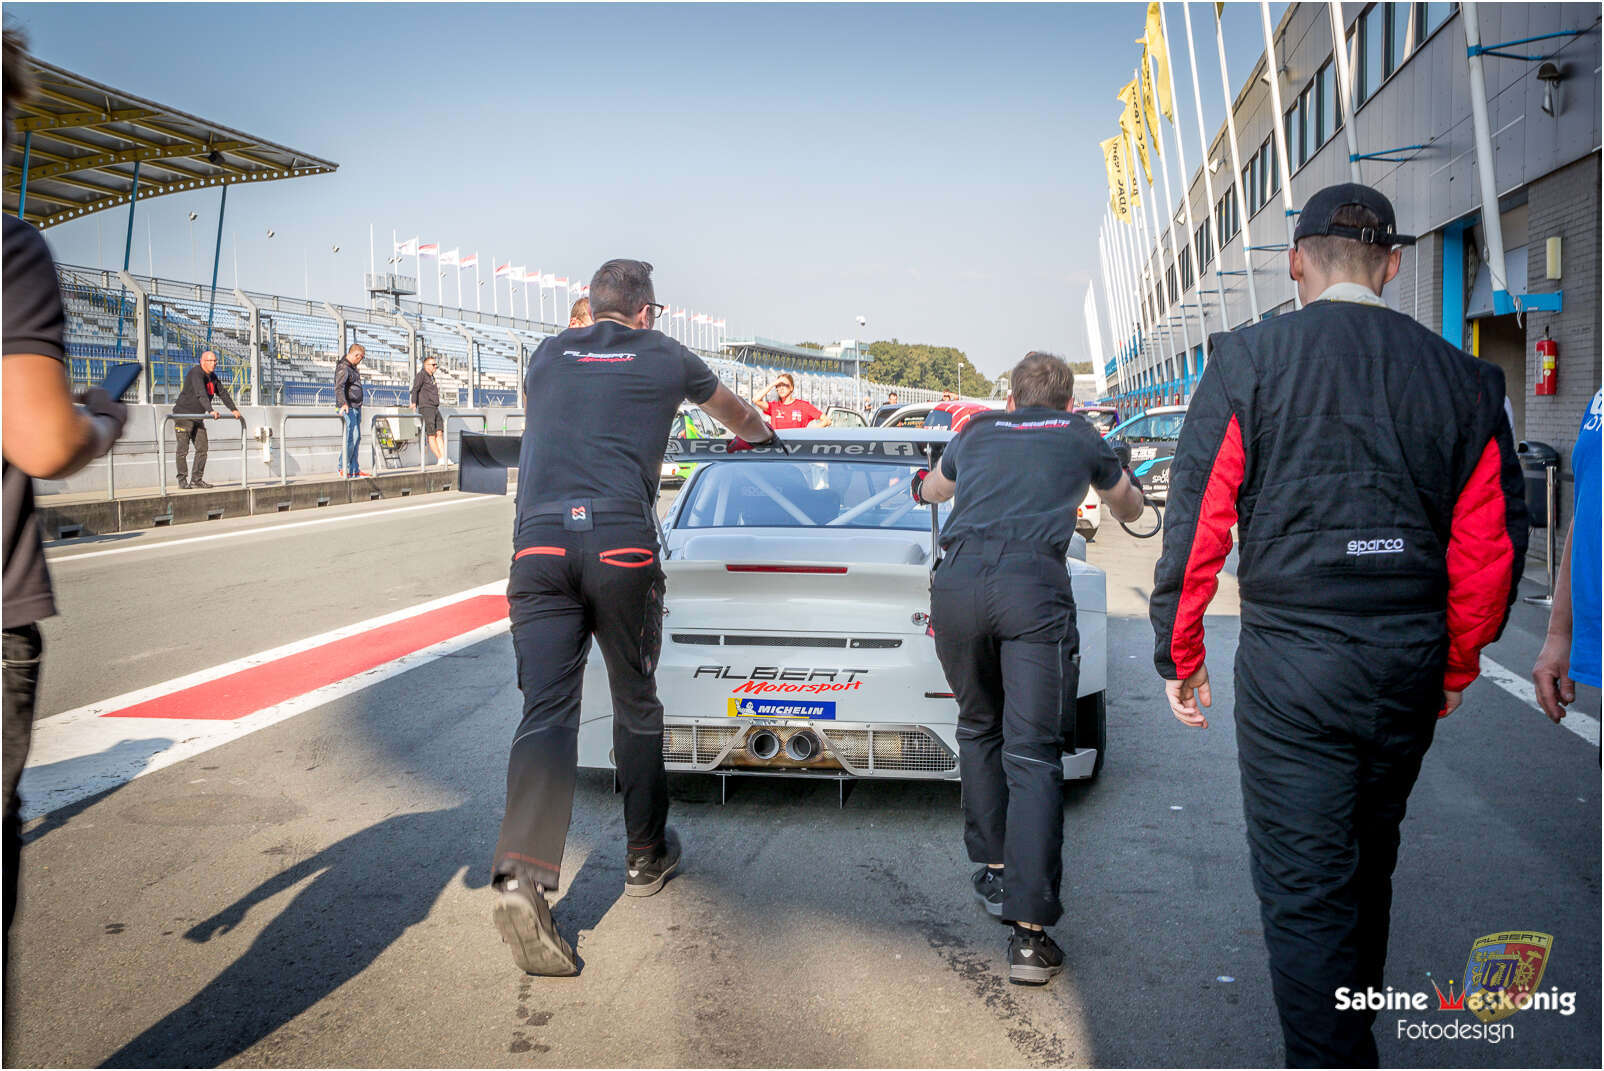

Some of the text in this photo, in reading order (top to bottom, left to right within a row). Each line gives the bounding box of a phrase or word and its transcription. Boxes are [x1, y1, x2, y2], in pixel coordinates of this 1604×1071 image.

[811, 441, 877, 455] me!
[1346, 538, 1404, 555] sparco
[693, 665, 869, 682] ALBERT
[732, 680, 863, 695] Motorsport
[757, 705, 824, 715] MICHELIN
